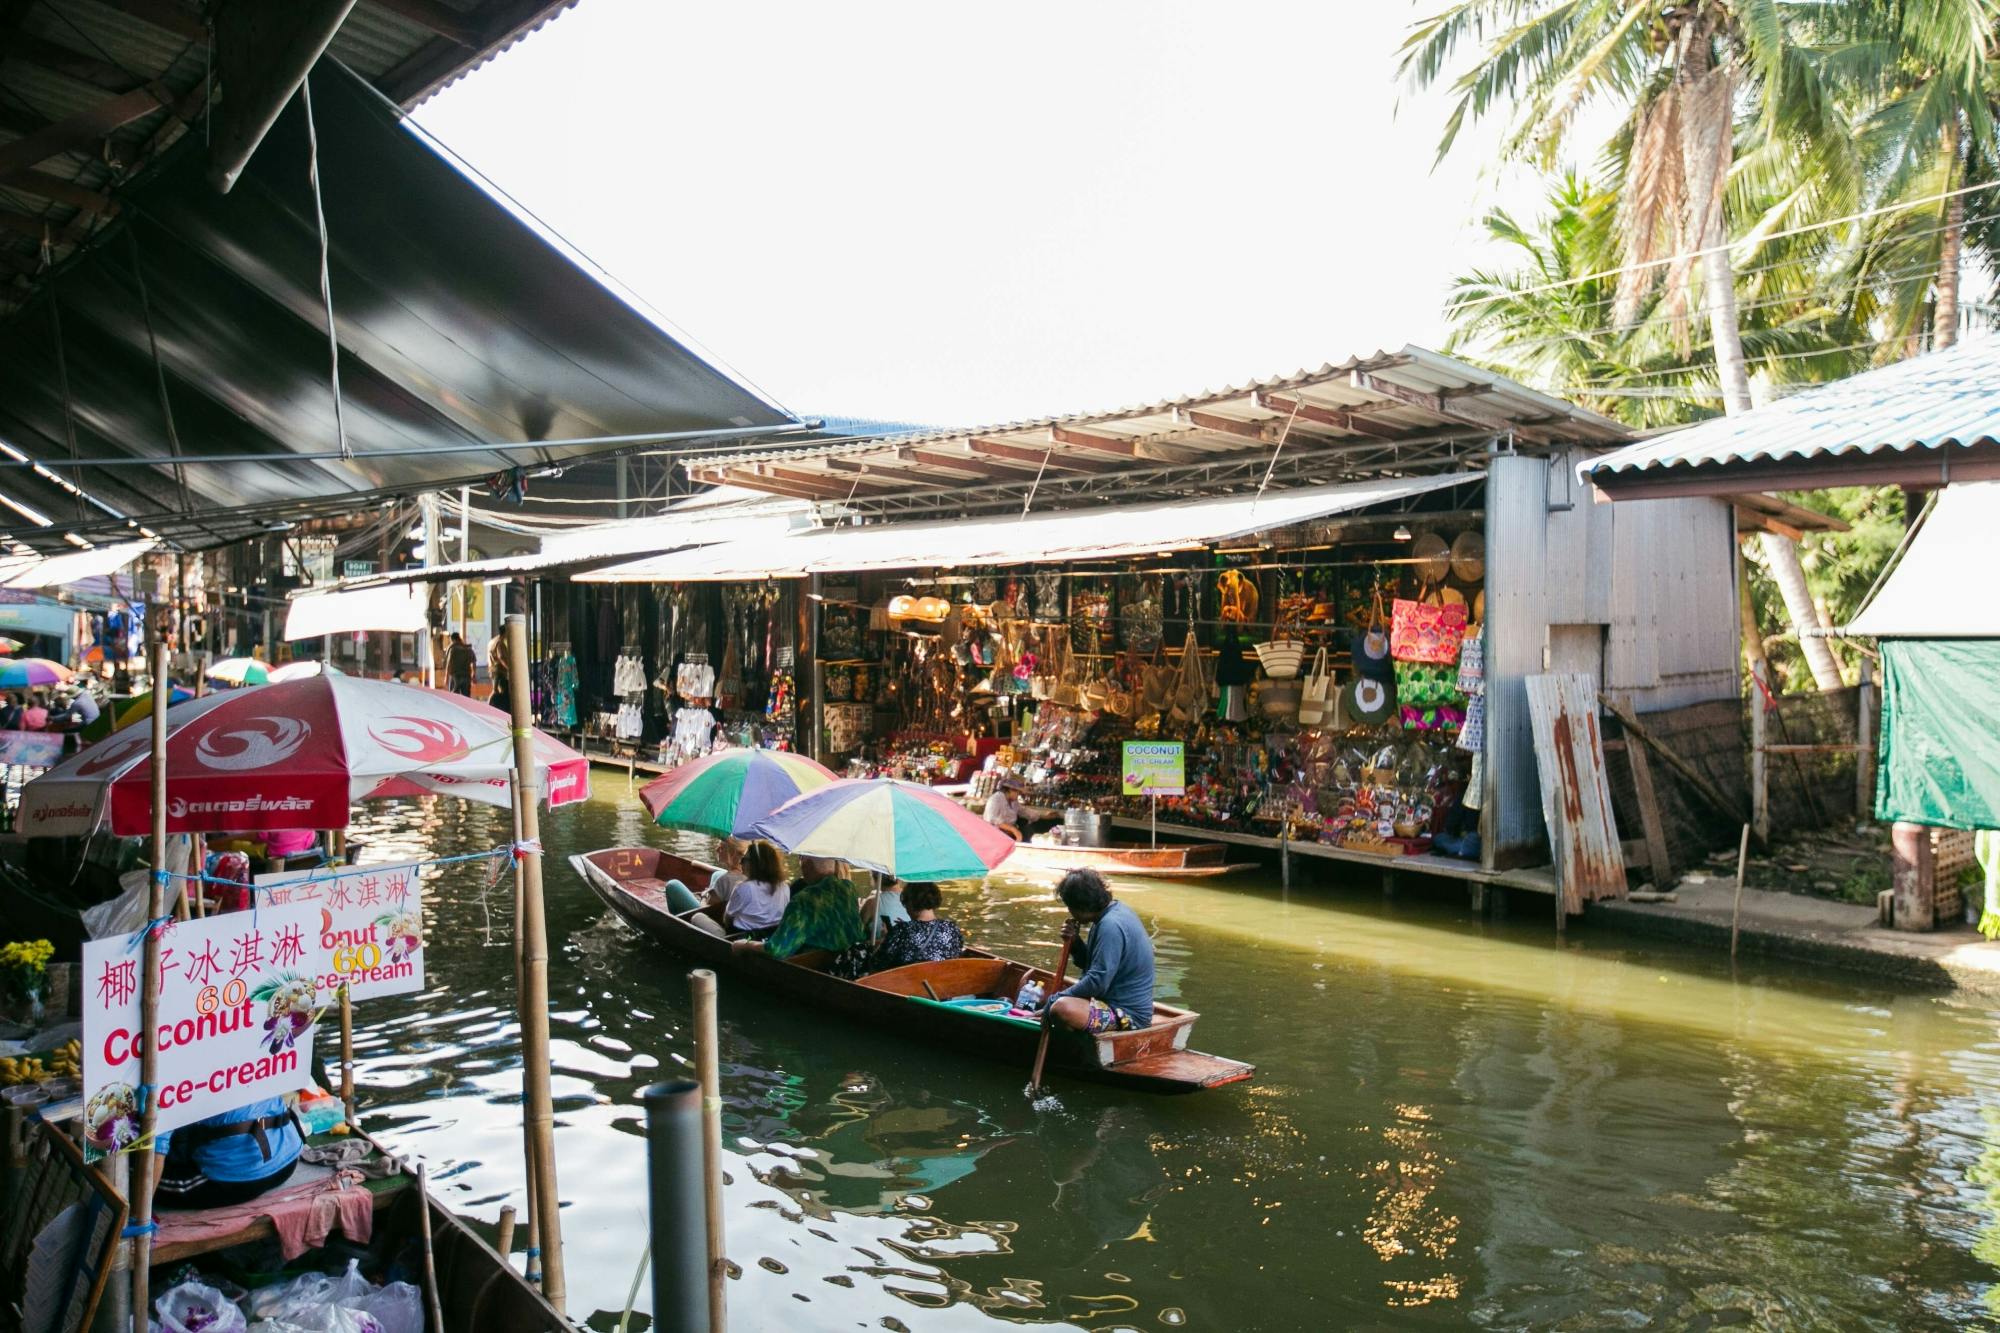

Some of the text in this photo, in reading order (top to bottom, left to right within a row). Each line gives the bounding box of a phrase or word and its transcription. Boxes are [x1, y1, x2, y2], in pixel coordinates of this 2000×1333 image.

[1127, 745, 1181, 755] COCONUT
[333, 943, 382, 974] 60
[314, 960, 413, 991] ce-cream
[196, 978, 247, 1015] 60
[157, 1050, 298, 1109] ce-cream
